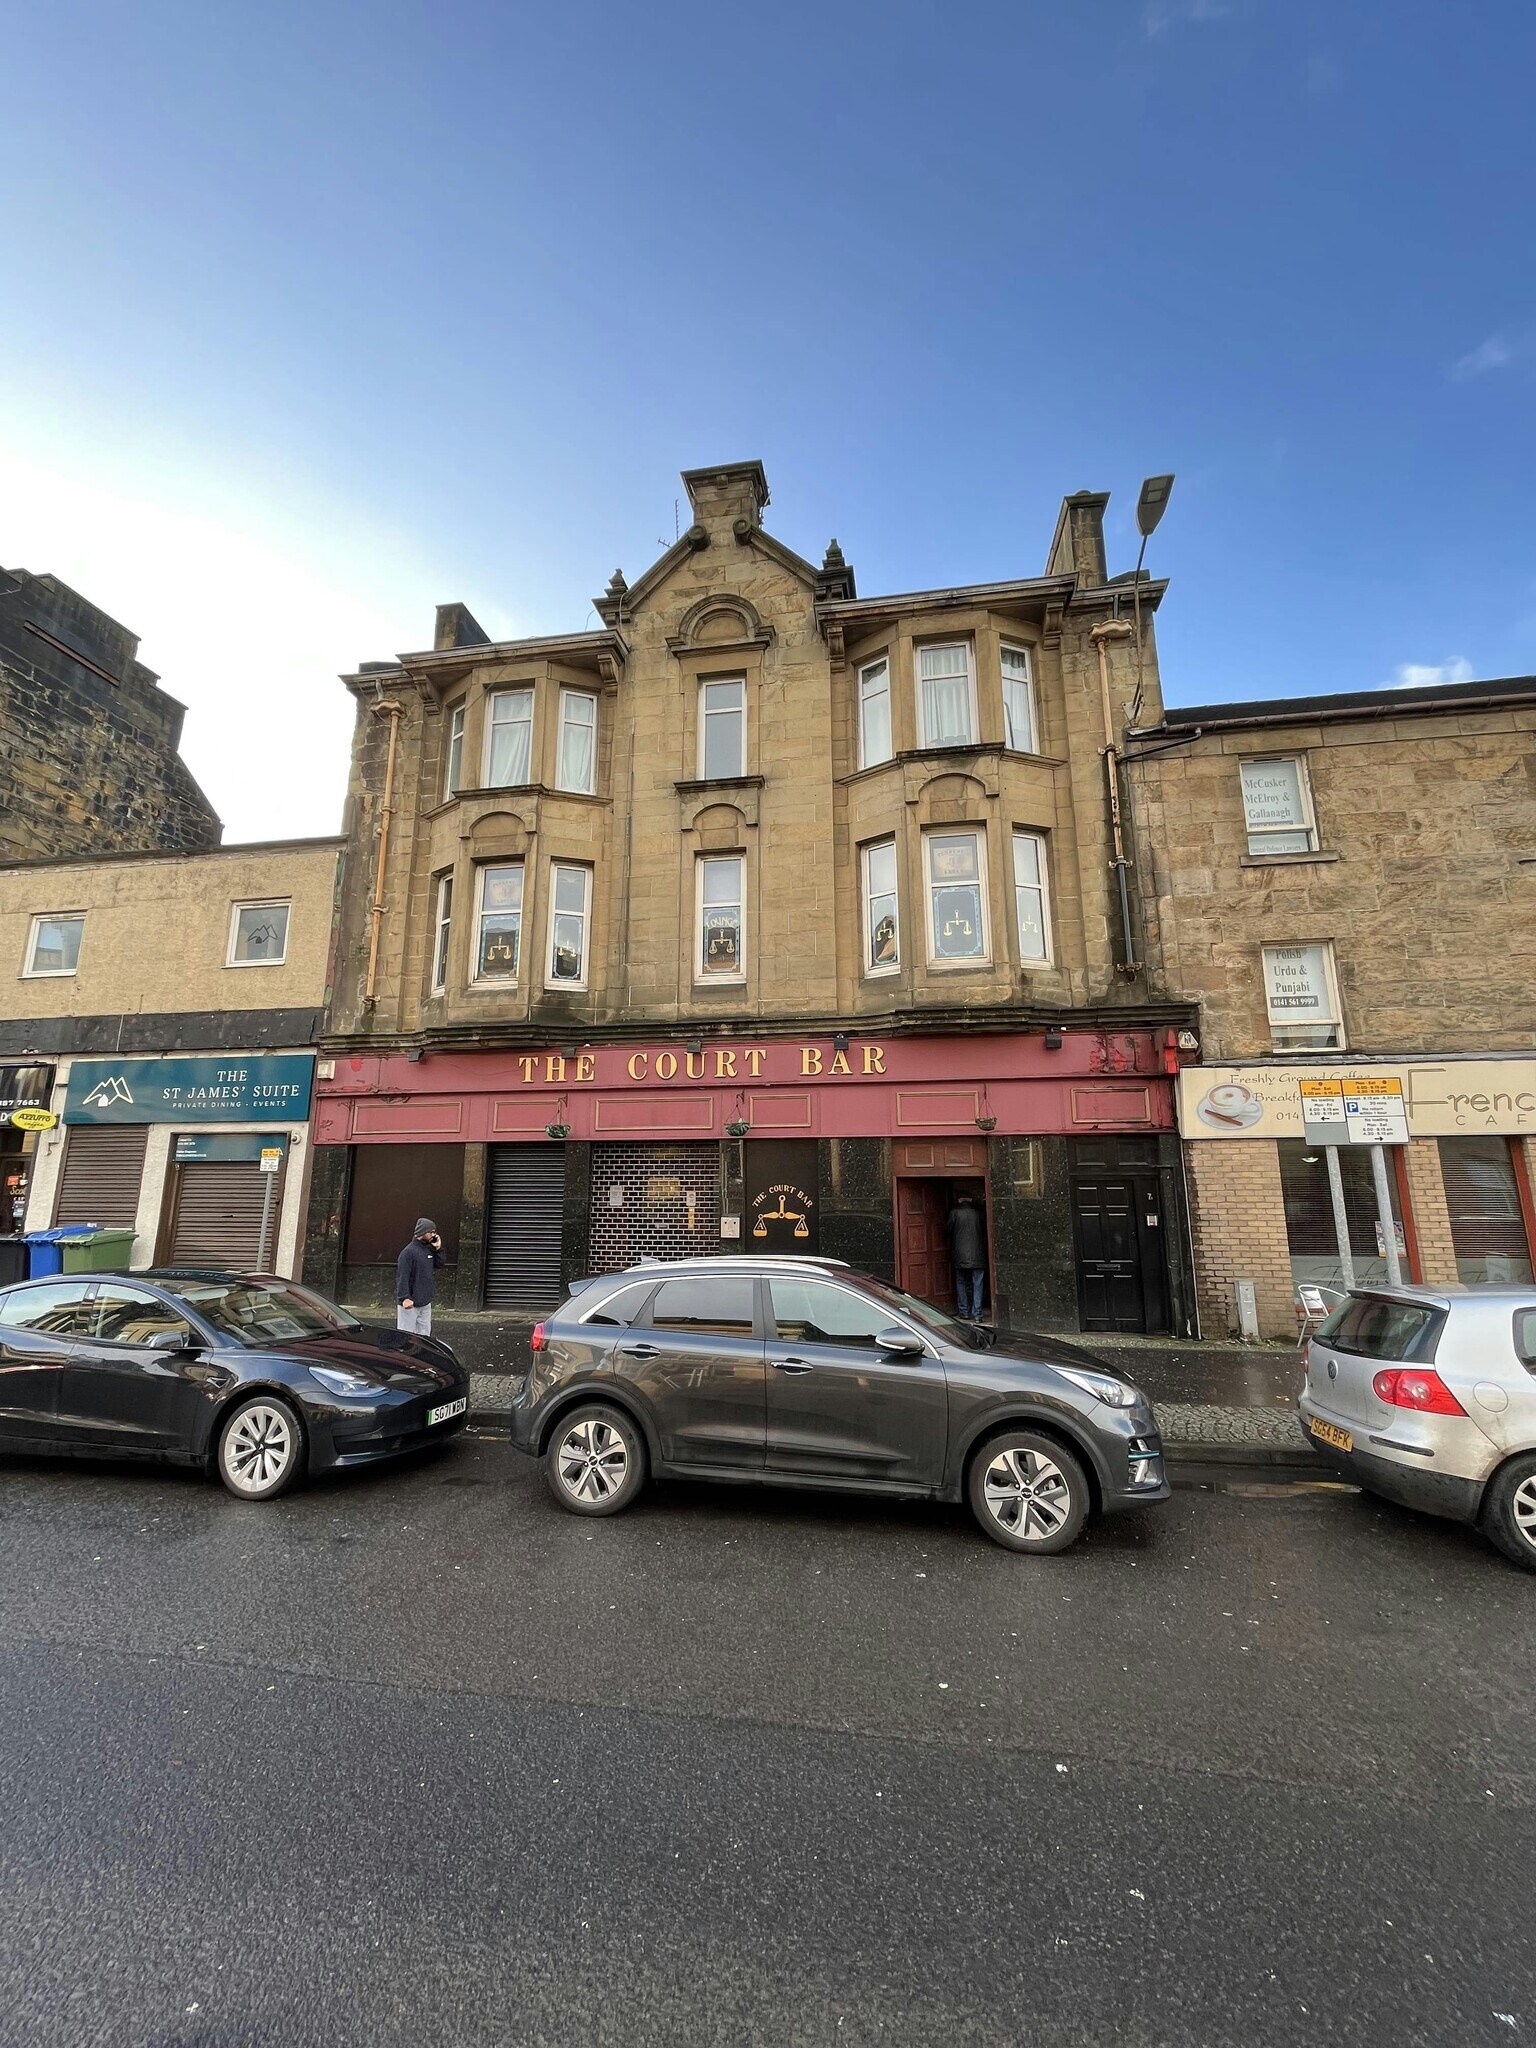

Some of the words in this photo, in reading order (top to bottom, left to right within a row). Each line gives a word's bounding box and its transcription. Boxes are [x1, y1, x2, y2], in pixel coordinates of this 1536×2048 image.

[1245, 778, 1287, 789] McCusker
[1245, 793, 1280, 805] McElroy
[1282, 791, 1290, 802] &
[707, 917, 737, 929] LOUNGE
[1273, 965, 1297, 976] Urdu
[1299, 964, 1308, 975] &
[1275, 981, 1310, 994] Punjabi
[518, 1055, 596, 1083] THE
[627, 1049, 769, 1081] COURT
[800, 1046, 887, 1076] BAR
[217, 1070, 248, 1082] THE
[1230, 1073, 1275, 1086] Freshly
[162, 1087, 181, 1099] ST
[252, 1084, 300, 1098] SUITE
[752, 1191, 767, 1207] THE
[768, 1184, 797, 1194] COURT
[796, 1190, 813, 1208] BAR
[1312, 1419, 1331, 1439] SG54
[1332, 1428, 1350, 1447] BFK
